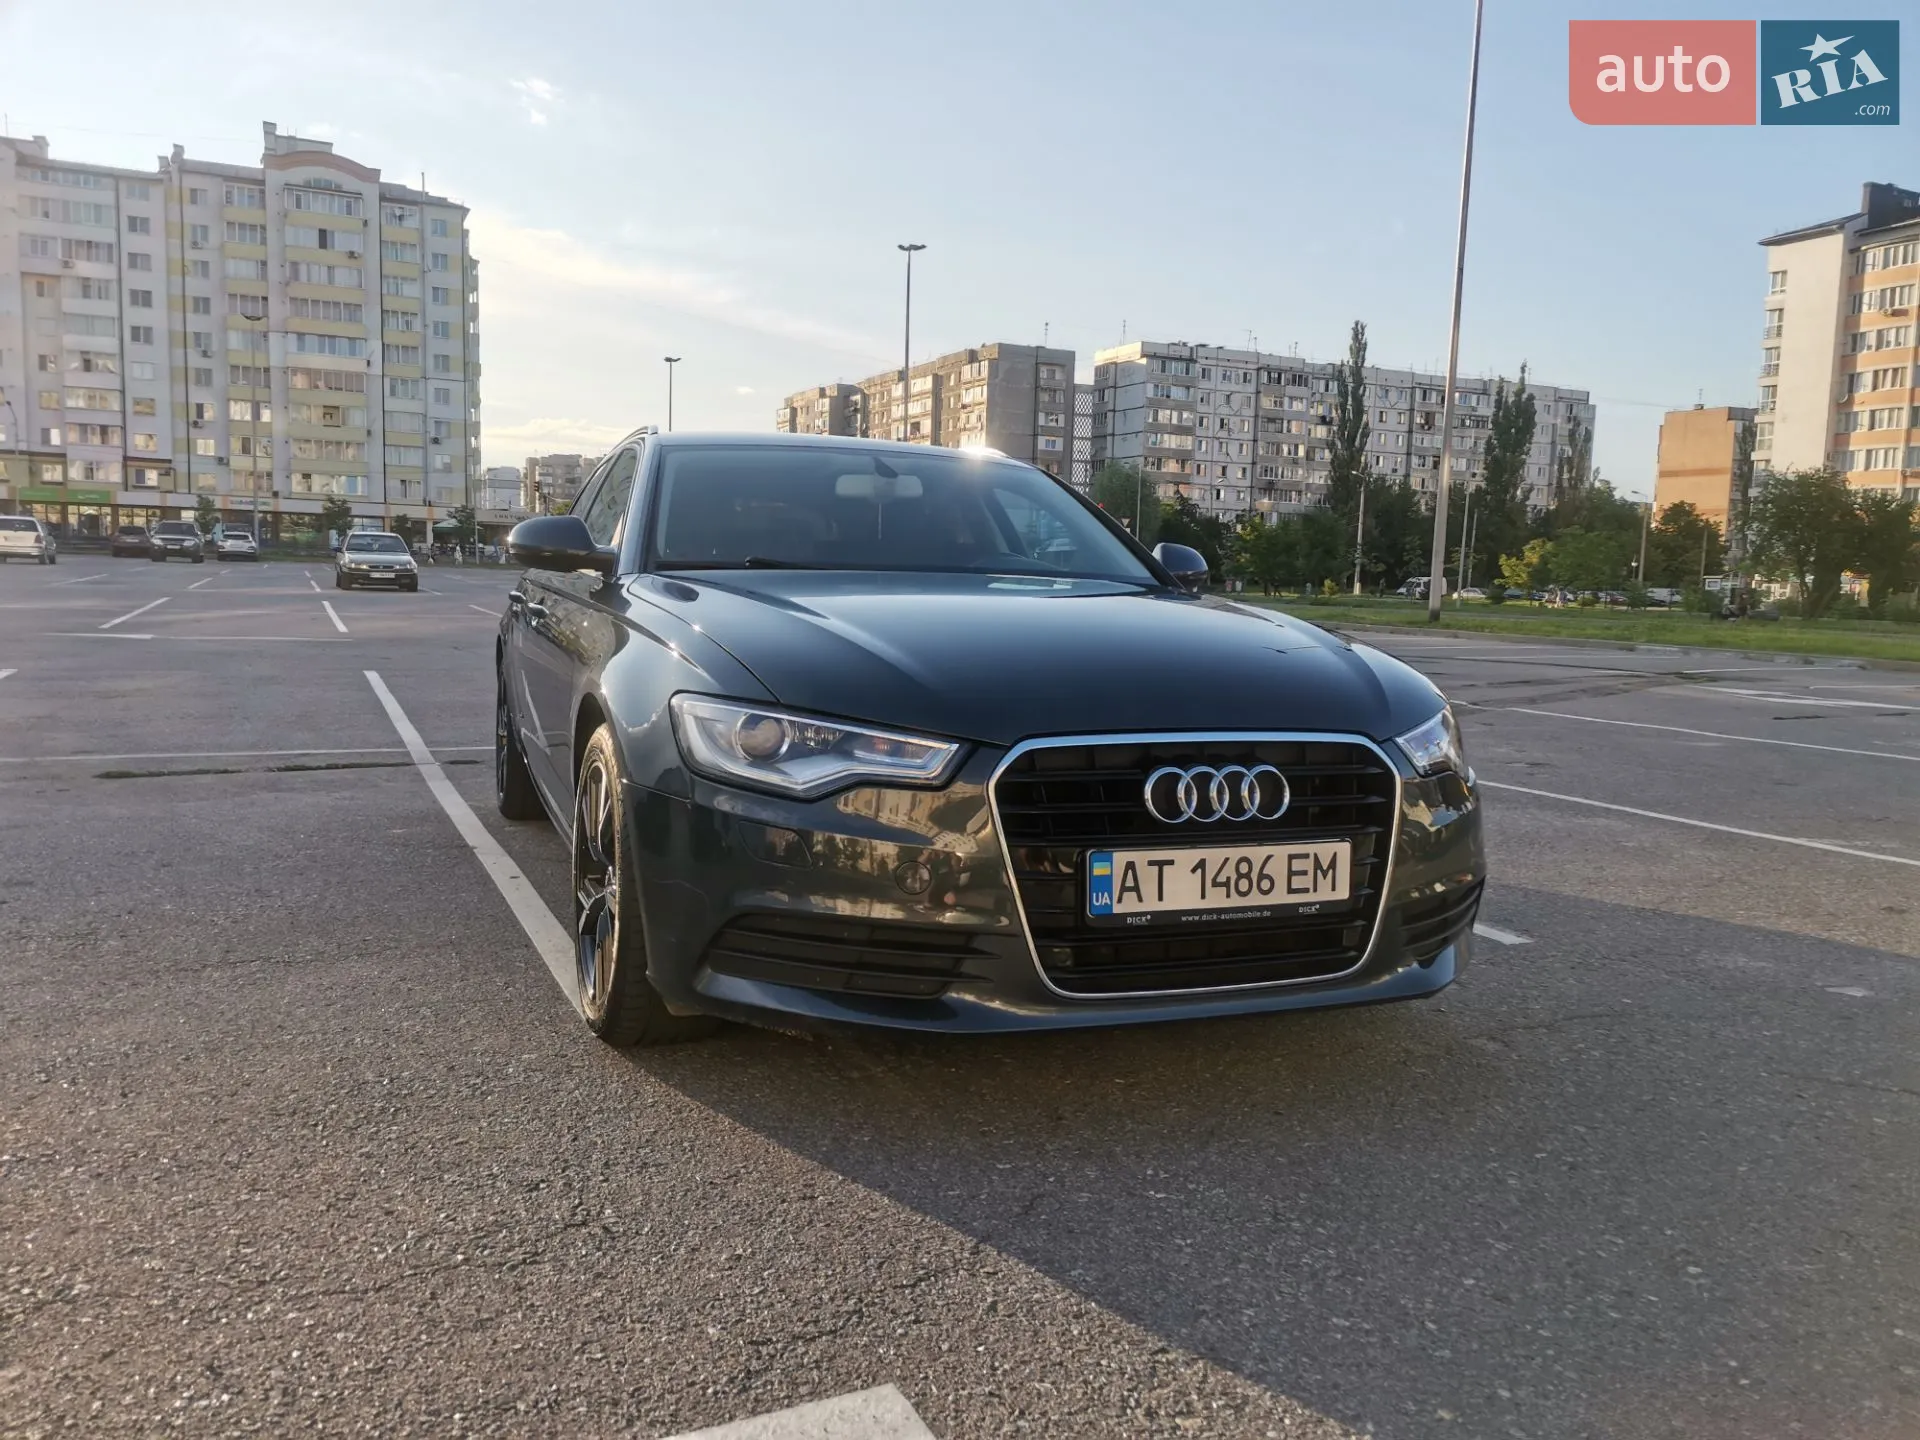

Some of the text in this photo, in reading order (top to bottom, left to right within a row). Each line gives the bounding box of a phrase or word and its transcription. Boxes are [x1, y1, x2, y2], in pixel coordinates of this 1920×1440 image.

[1116, 851, 1338, 904] AT 1486 EM
[1092, 891, 1111, 906] UA
[1181, 910, 1272, 922] www.dick-automobile.de
